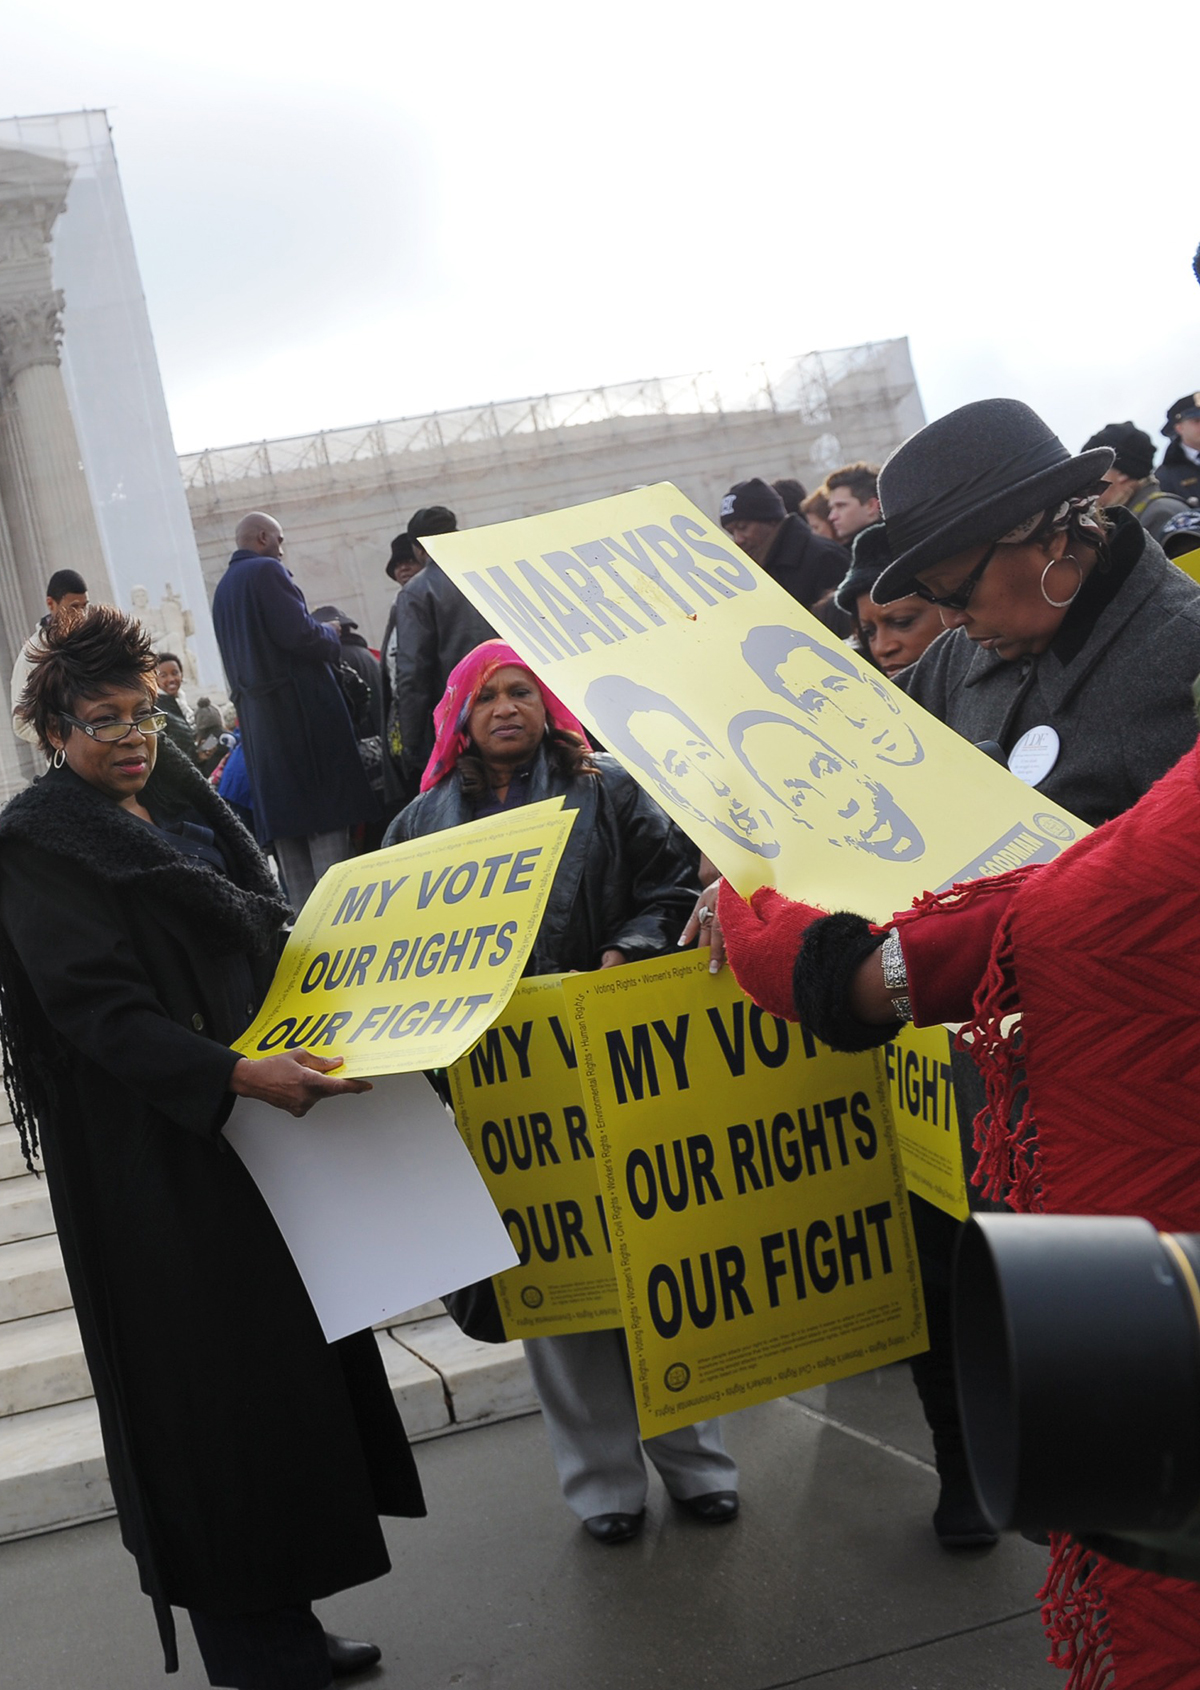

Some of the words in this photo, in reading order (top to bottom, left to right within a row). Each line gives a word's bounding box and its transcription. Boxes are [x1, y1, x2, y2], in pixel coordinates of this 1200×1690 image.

[462, 514, 758, 666] MARTYRS
[331, 876, 409, 926] MY
[416, 847, 543, 910] VOTE
[301, 945, 377, 994] OUR
[377, 921, 518, 983] RIGHTS
[594, 982, 615, 995] Voting
[616, 978, 638, 992] Rights
[642, 970, 673, 984] Women's
[672, 966, 693, 980] Rights
[257, 1011, 353, 1051] OUR
[346, 993, 493, 1044] FIGHT
[575, 994, 585, 1021] Rights
[581, 1020, 589, 1047] Human
[470, 1020, 534, 1088] MY
[584, 1053, 596, 1078] Rights
[605, 1013, 691, 1105] MY
[706, 1001, 817, 1077] VO
[587, 1077, 606, 1130] Environmental
[885, 1043, 953, 1132] FIGHT
[481, 1111, 562, 1176] OUR
[600, 1135, 612, 1159] Rights
[625, 1133, 724, 1222] OUR
[726, 1091, 878, 1196] RIGHTS
[602, 1159, 615, 1196] Worker's
[611, 1196, 622, 1221] Rights
[502, 1199, 594, 1267] OUR
[616, 1221, 625, 1237] Civil
[620, 1241, 631, 1268] Rights
[647, 1245, 755, 1339] OUR
[760, 1201, 893, 1308] FIGHT
[621, 1266, 635, 1301] Women's
[631, 1306, 642, 1331] Rights
[634, 1330, 644, 1353] Voting
[639, 1358, 649, 1382] Rights
